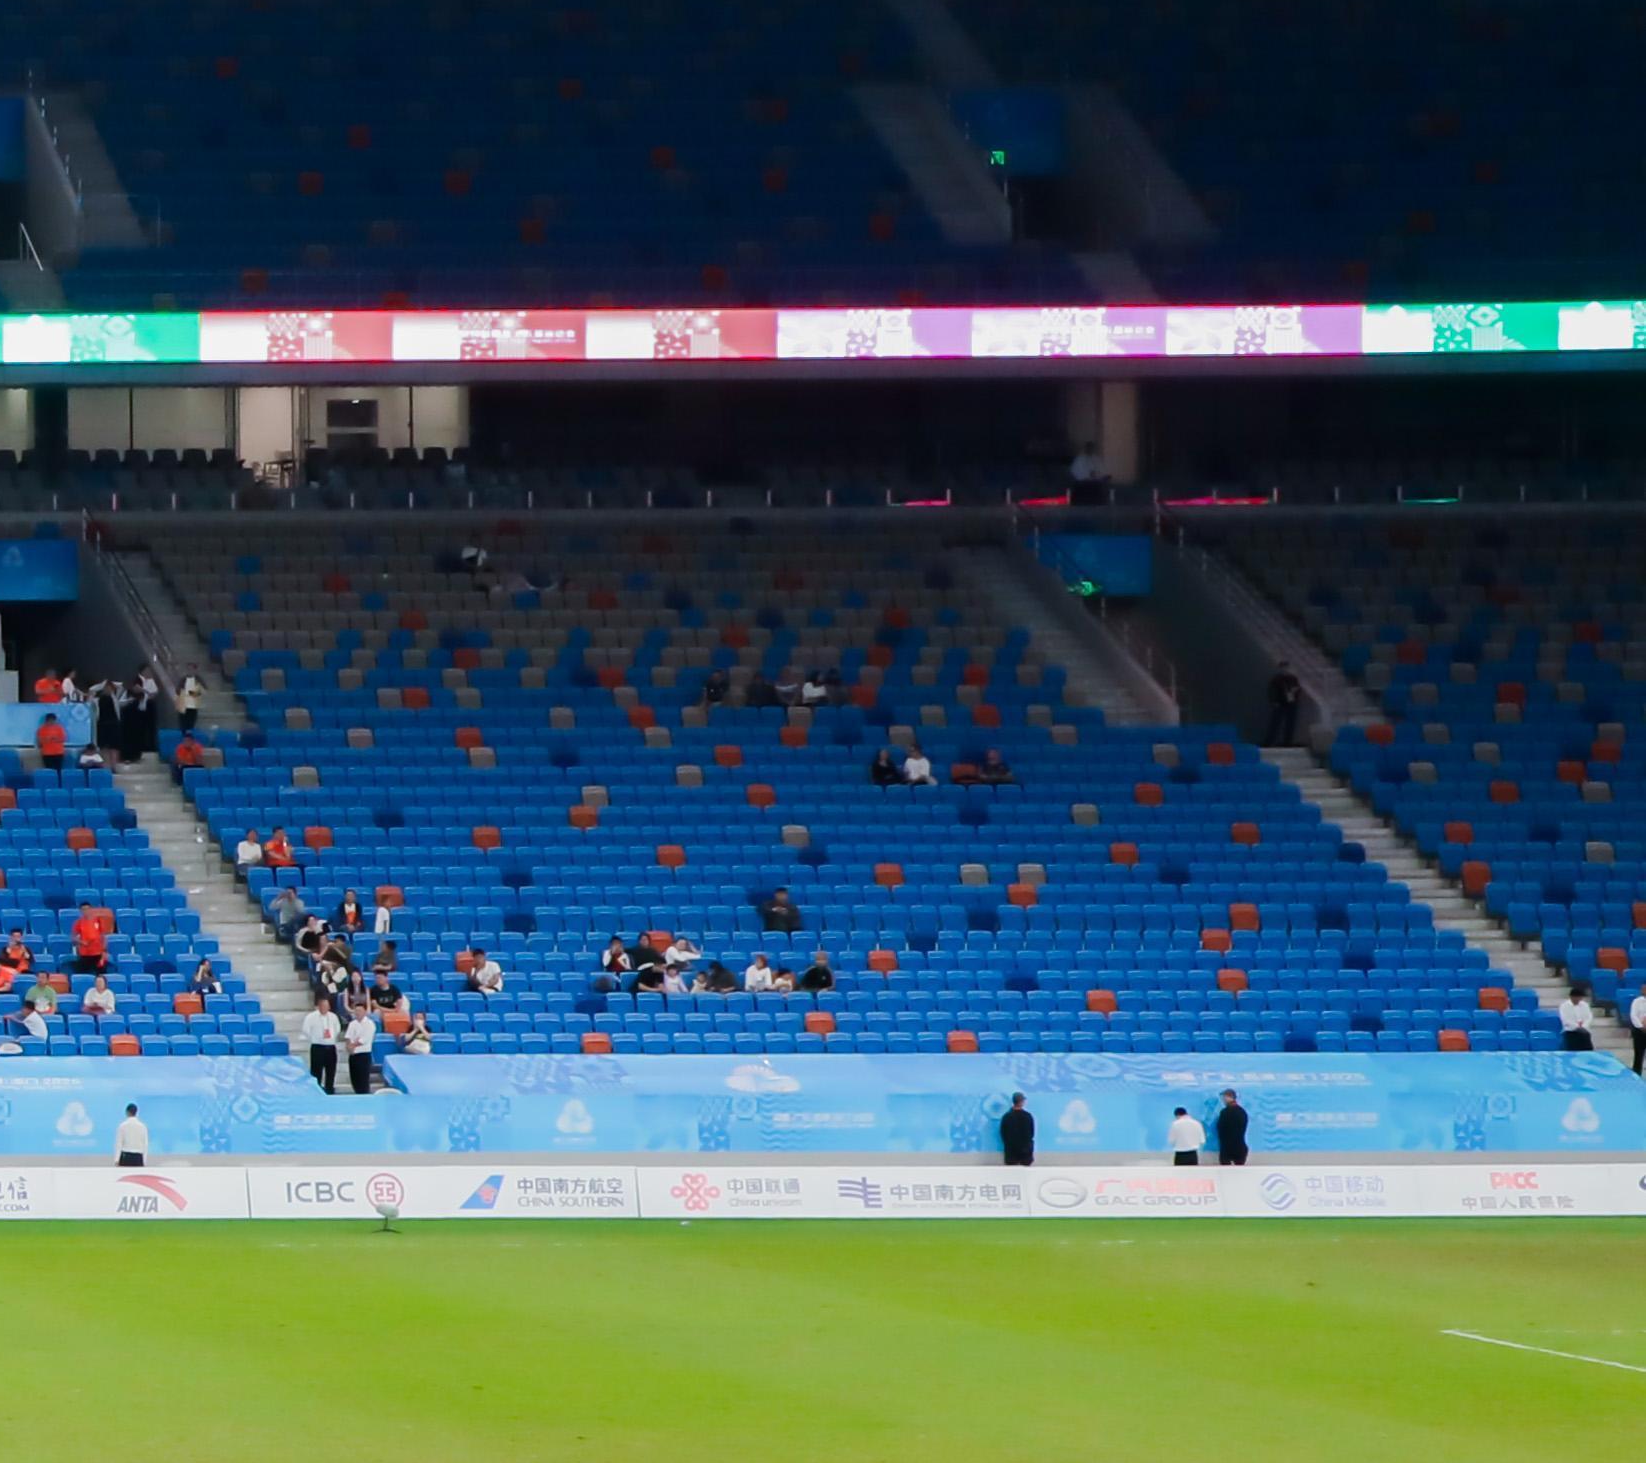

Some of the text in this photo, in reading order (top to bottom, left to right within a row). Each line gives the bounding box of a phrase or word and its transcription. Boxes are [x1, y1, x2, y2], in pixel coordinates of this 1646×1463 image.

[517, 1177, 623, 1194] 中国南方航空
[727, 1178, 801, 1194] 中国联通
[1094, 1176, 1216, 1195] 广汽集团
[1304, 1175, 1385, 1193] 中国移动
[1489, 1172, 1539, 1190] PICC
[286, 1182, 355, 1203] ICBC
[517, 1194, 624, 1208] CHINA SOUTHERN
[890, 1184, 1021, 1201] 中国南方电网
[1094, 1194, 1219, 1207] GAC GROUP
[116, 1196, 158, 1213] ANTA
